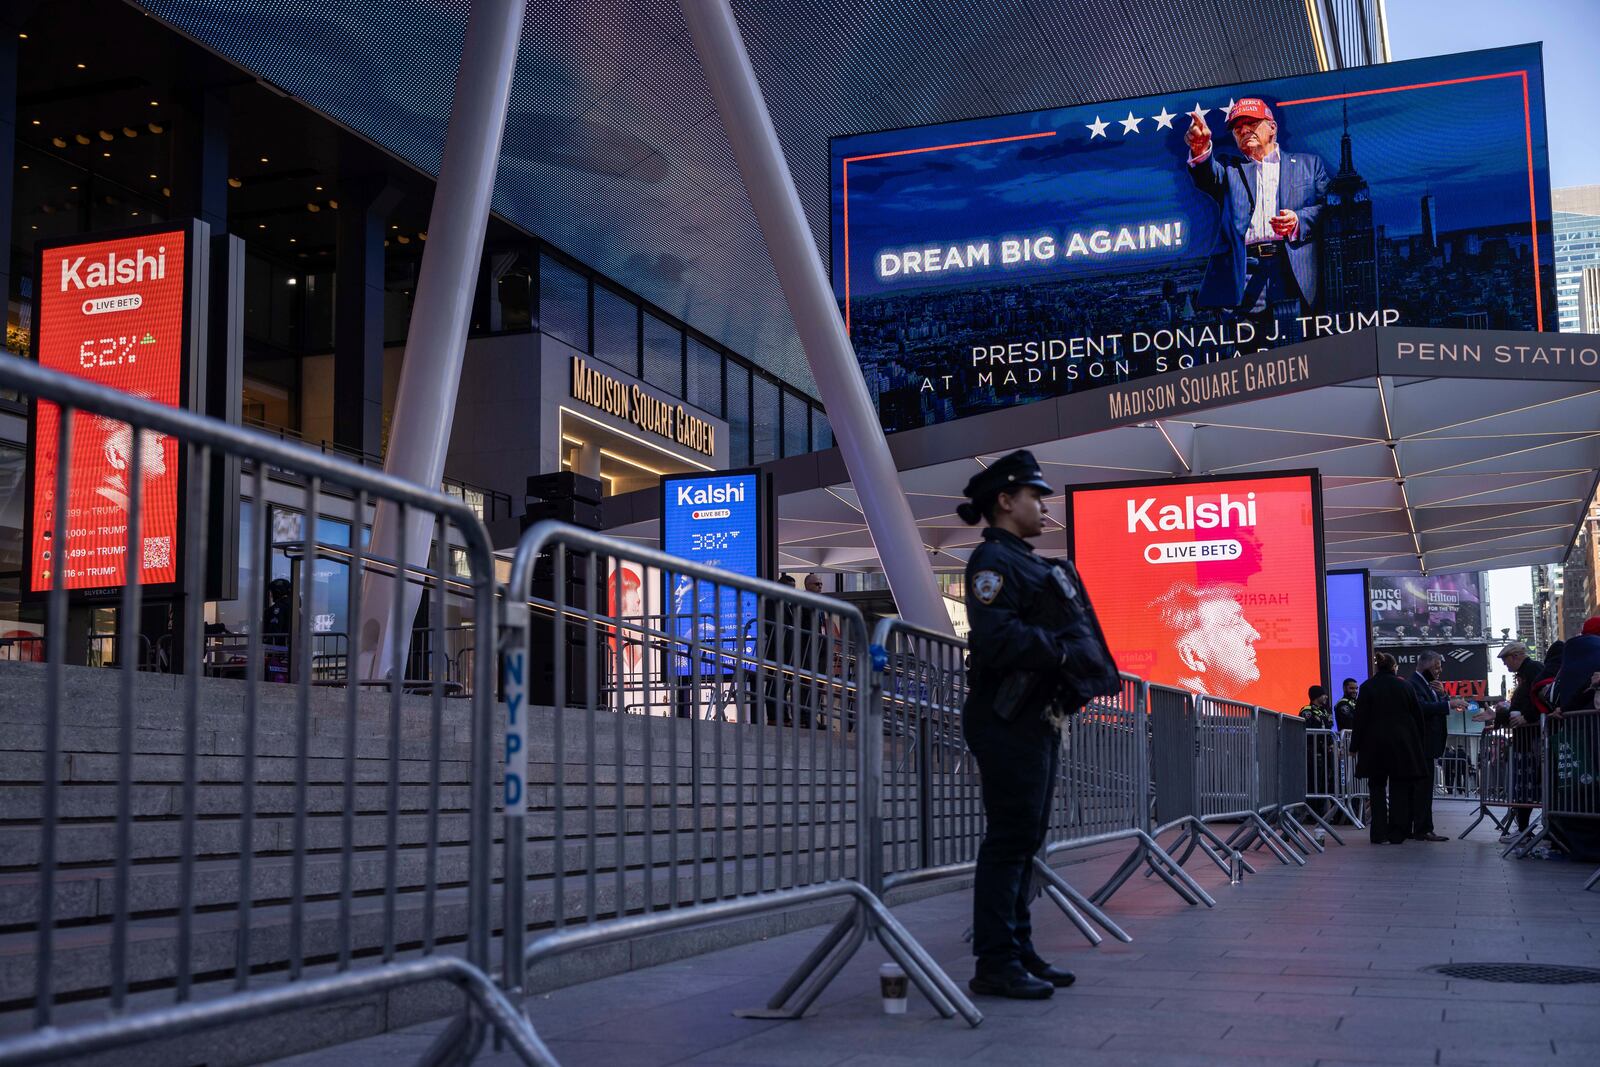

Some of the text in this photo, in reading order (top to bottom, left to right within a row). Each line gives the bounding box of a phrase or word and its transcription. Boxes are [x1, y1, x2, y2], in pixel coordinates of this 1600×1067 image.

[880, 222, 1183, 277] DREAM BIG AGAIN!
[60, 246, 166, 292] Kalshi
[96, 296, 141, 311] LIVE BETS
[972, 309, 1400, 367] PRESIDENT DONALD J. TRUMP
[80, 335, 137, 368] 62%
[1397, 342, 1598, 366] PENN STATIO
[920, 348, 1269, 393] AT MADISON SQU
[1109, 355, 1310, 420] MADISON SQUARE GARDEN
[573, 356, 715, 457] MADISON SQUARE GARDEN
[676, 482, 745, 507] Kalshi
[92, 506, 122, 516] TRUMP
[1126, 492, 1257, 533] Kalshi
[97, 526, 128, 536] TRUMP
[691, 533, 729, 551] 38%
[96, 546, 127, 556] TRUMP
[1166, 544, 1238, 559] LIVE BETS
[86, 566, 117, 576] TRUMP
[1372, 600, 1402, 611] ON
[1430, 592, 1457, 603] Hilton
[504, 653, 523, 806] NYPD
